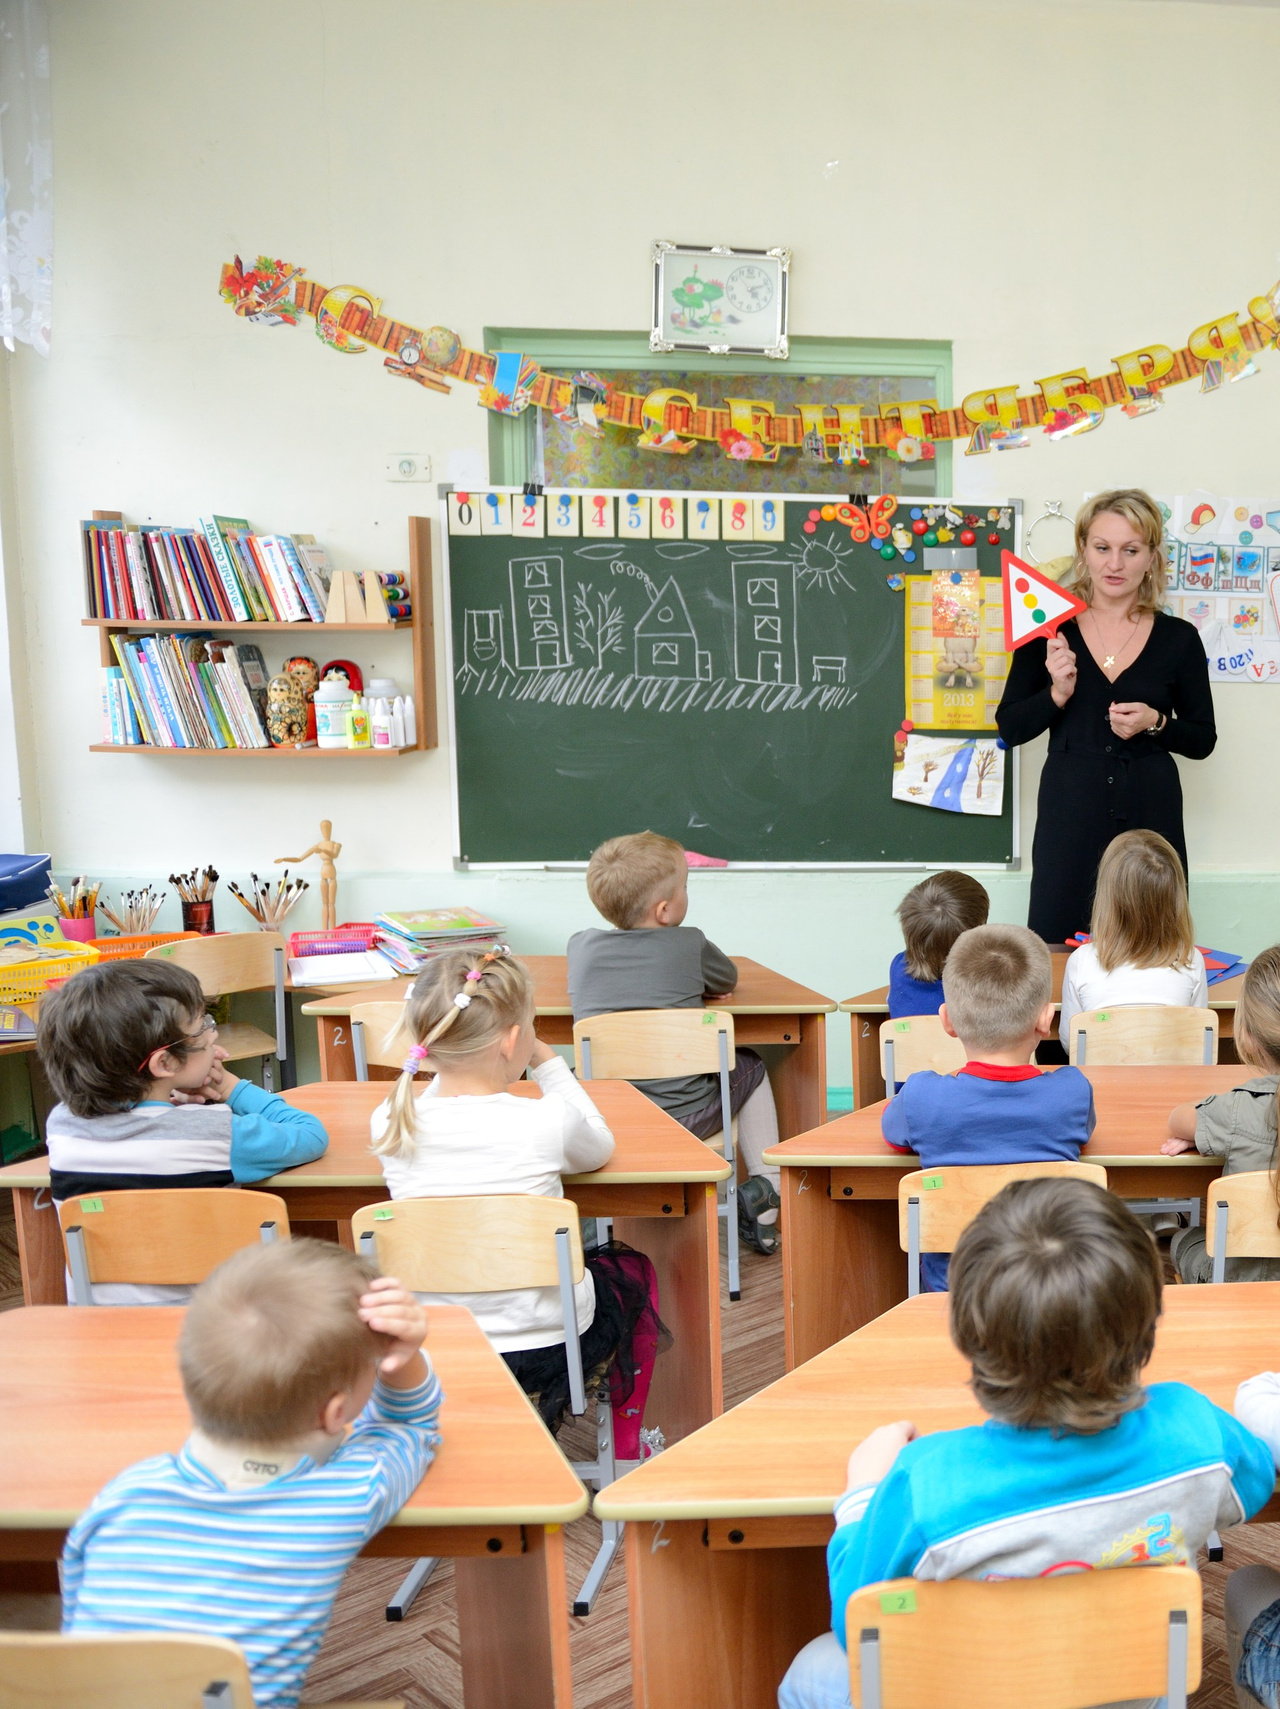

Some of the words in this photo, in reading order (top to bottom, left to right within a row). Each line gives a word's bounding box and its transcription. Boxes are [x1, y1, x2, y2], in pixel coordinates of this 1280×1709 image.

[316, 284, 384, 354] С
[458, 502, 472, 526] 0
[492, 505, 503, 526] 1
[522, 505, 535, 527] 2
[557, 504, 571, 527] 3
[592, 505, 606, 527] 4
[628, 506, 641, 529] 5
[661, 506, 675, 529] 6
[696, 508, 710, 530] 7
[731, 510, 745, 531] 8
[762, 510, 776, 531] 9
[220, 563, 241, 609] ЗОЛОТЫЕ
[1229, 653, 1246, 669] 20
[943, 692, 975, 707] 2013
[333, 1027, 347, 1046] 2
[862, 1022, 870, 1038] 2
[798, 1170, 811, 1195] 2
[932, 1180, 937, 1188] 1
[34, 1187, 51, 1210] 2
[651, 1519, 670, 1554] 2
[1146, 1511, 1172, 1557] 2
[897, 1597, 906, 1609] 2
